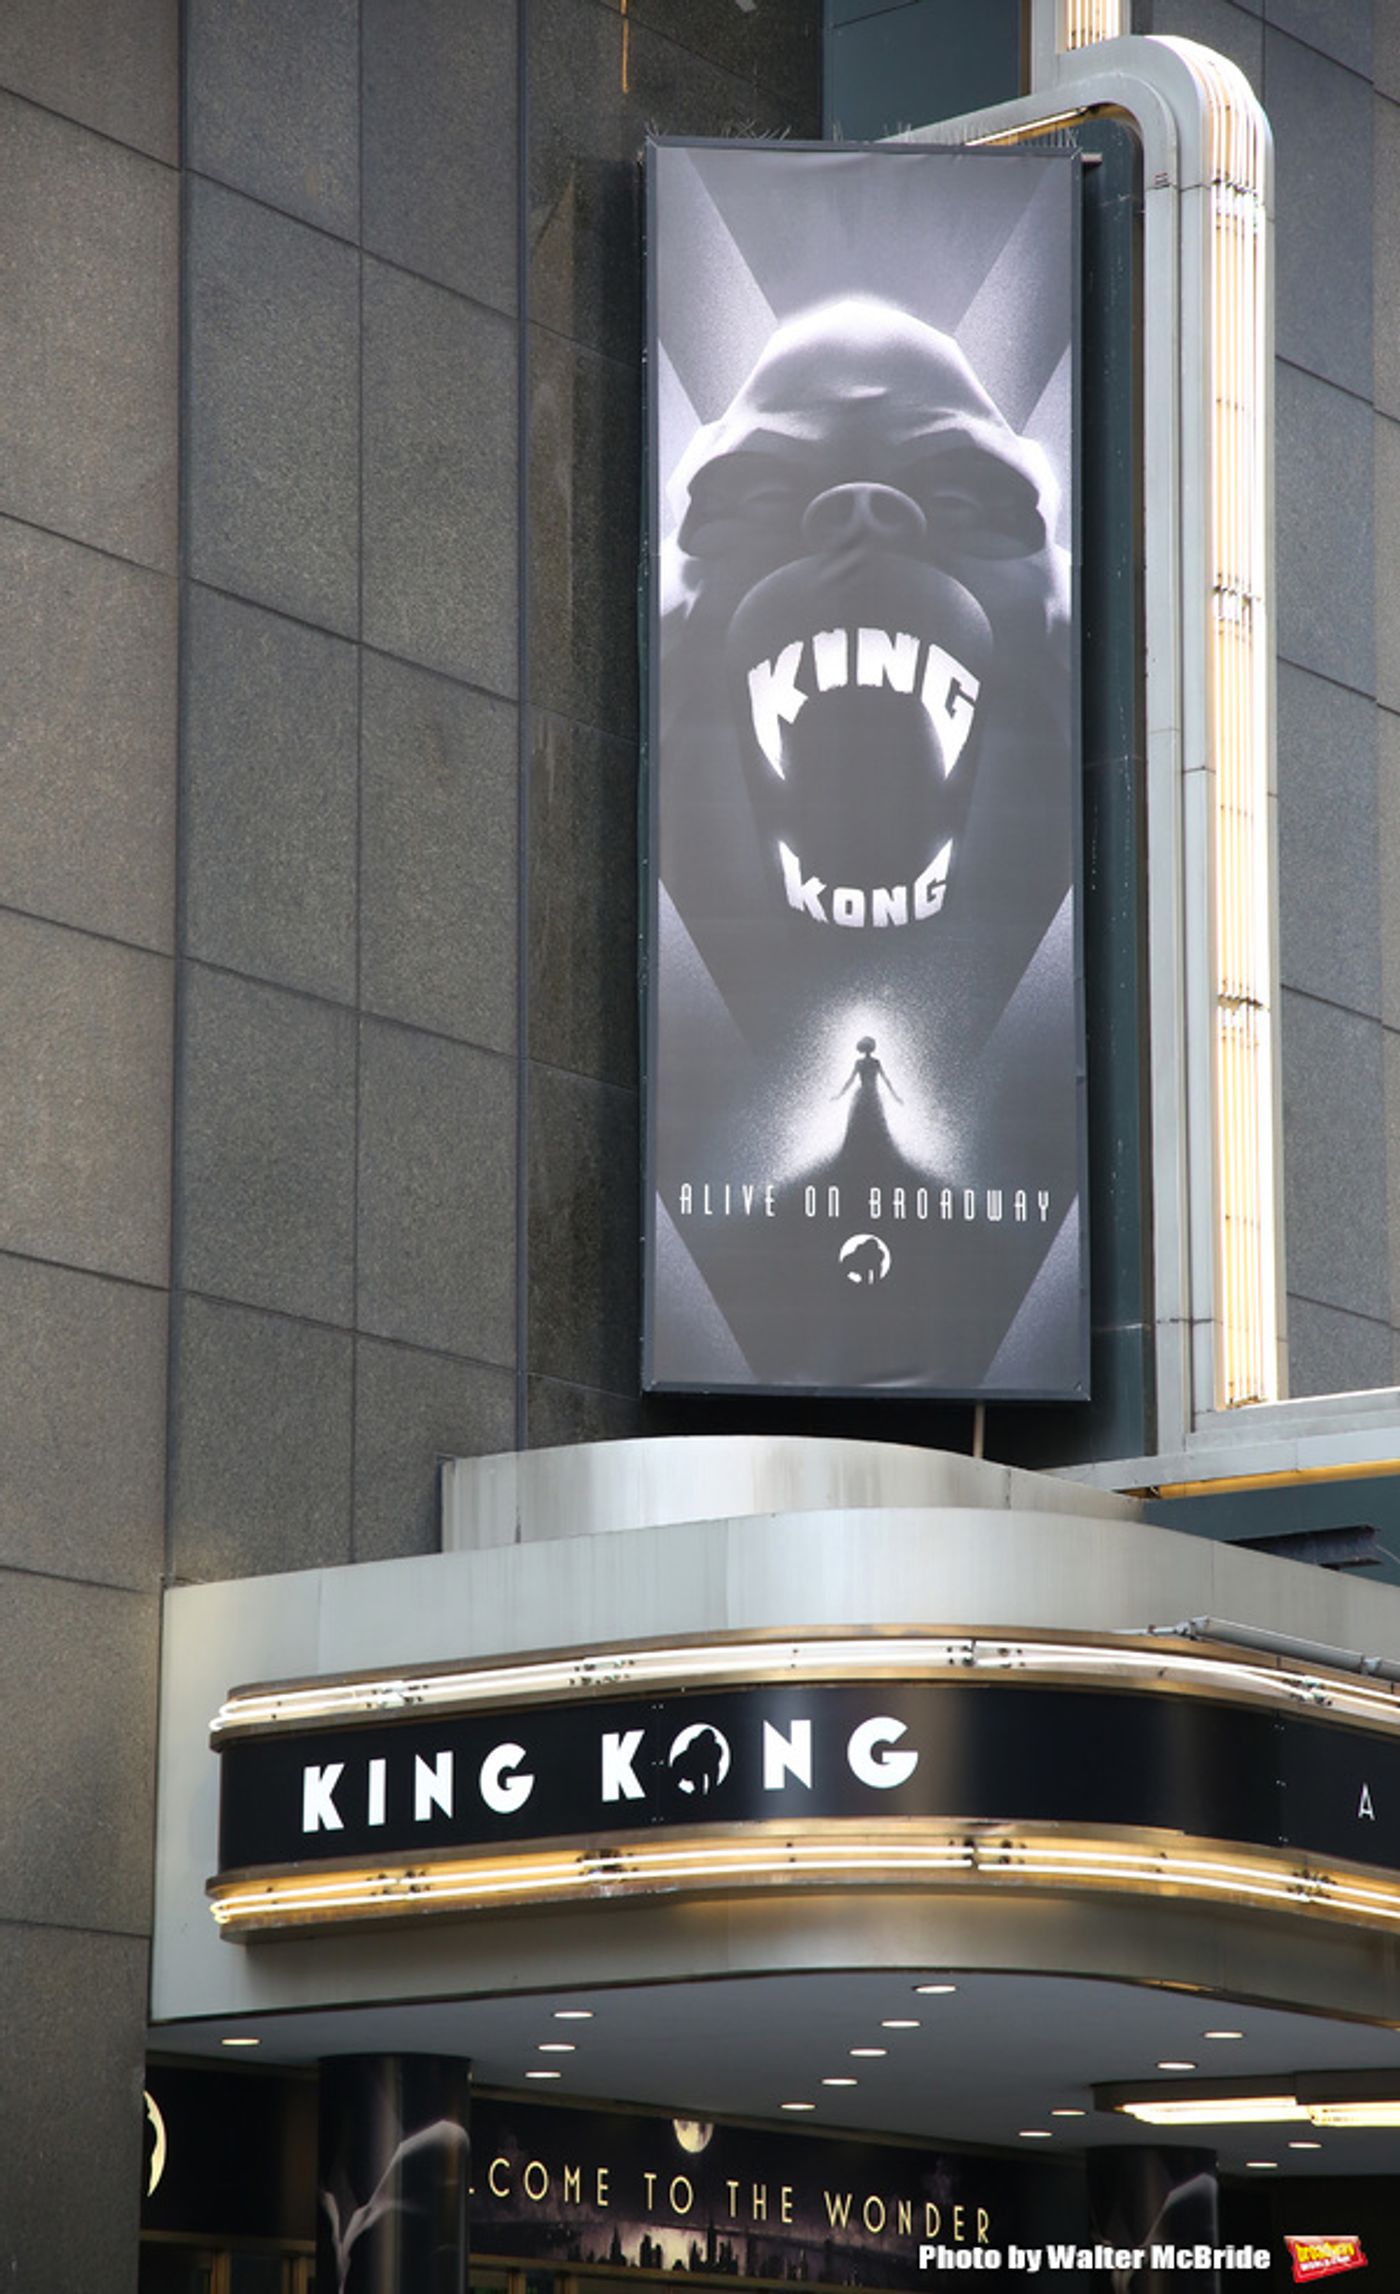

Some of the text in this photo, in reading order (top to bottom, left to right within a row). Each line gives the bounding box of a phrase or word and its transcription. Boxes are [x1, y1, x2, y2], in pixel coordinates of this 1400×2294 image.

[749, 627, 980, 780] KING
[778, 838, 953, 927] KONG
[679, 1183, 1050, 1222] ALIVE ON BROADWAY
[303, 1743, 534, 1833] KING
[1358, 1784, 1375, 1821] A
[469, 2157, 990, 2244] COME TO THE WONDER
